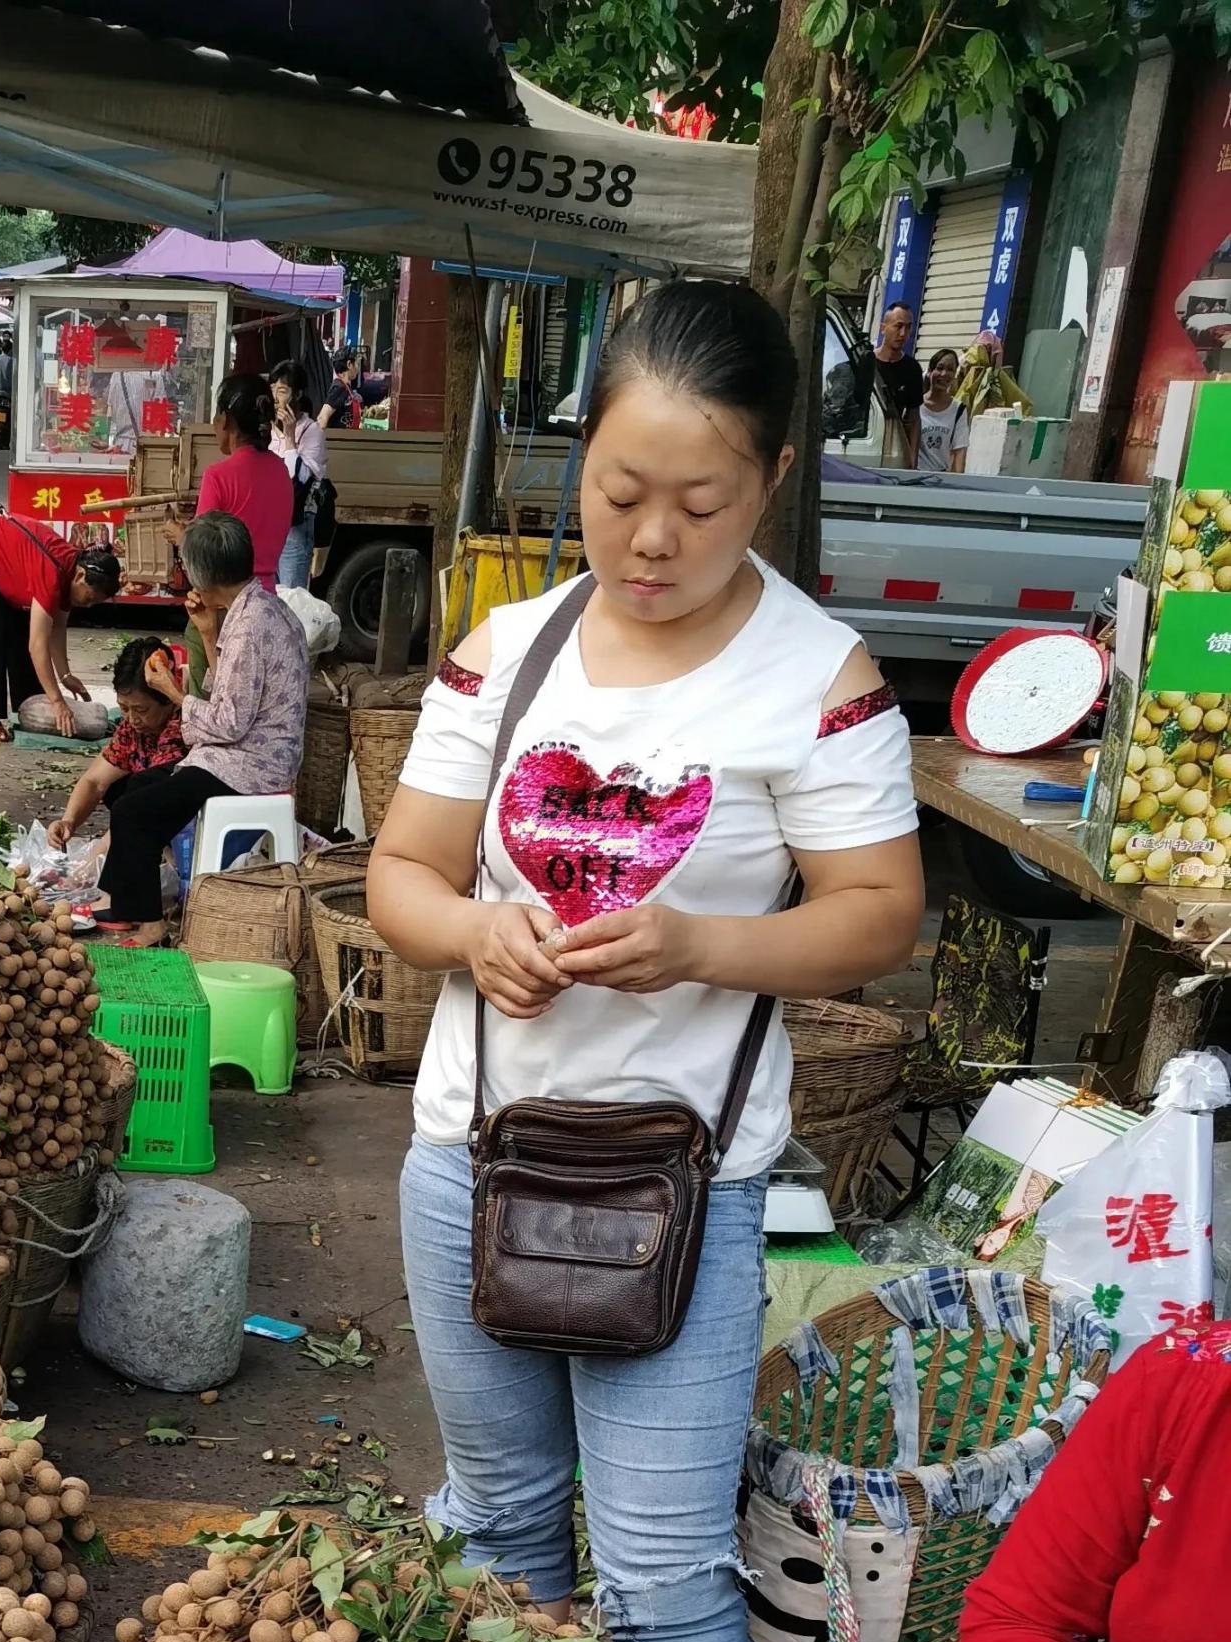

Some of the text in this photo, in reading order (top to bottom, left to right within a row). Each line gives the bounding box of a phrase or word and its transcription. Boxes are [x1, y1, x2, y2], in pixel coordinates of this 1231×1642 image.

[487, 145, 637, 208] 95338
[433, 190, 629, 234] www.sf-express.com
[994, 206, 1019, 284] 双虎
[545, 852, 635, 893] OFF
